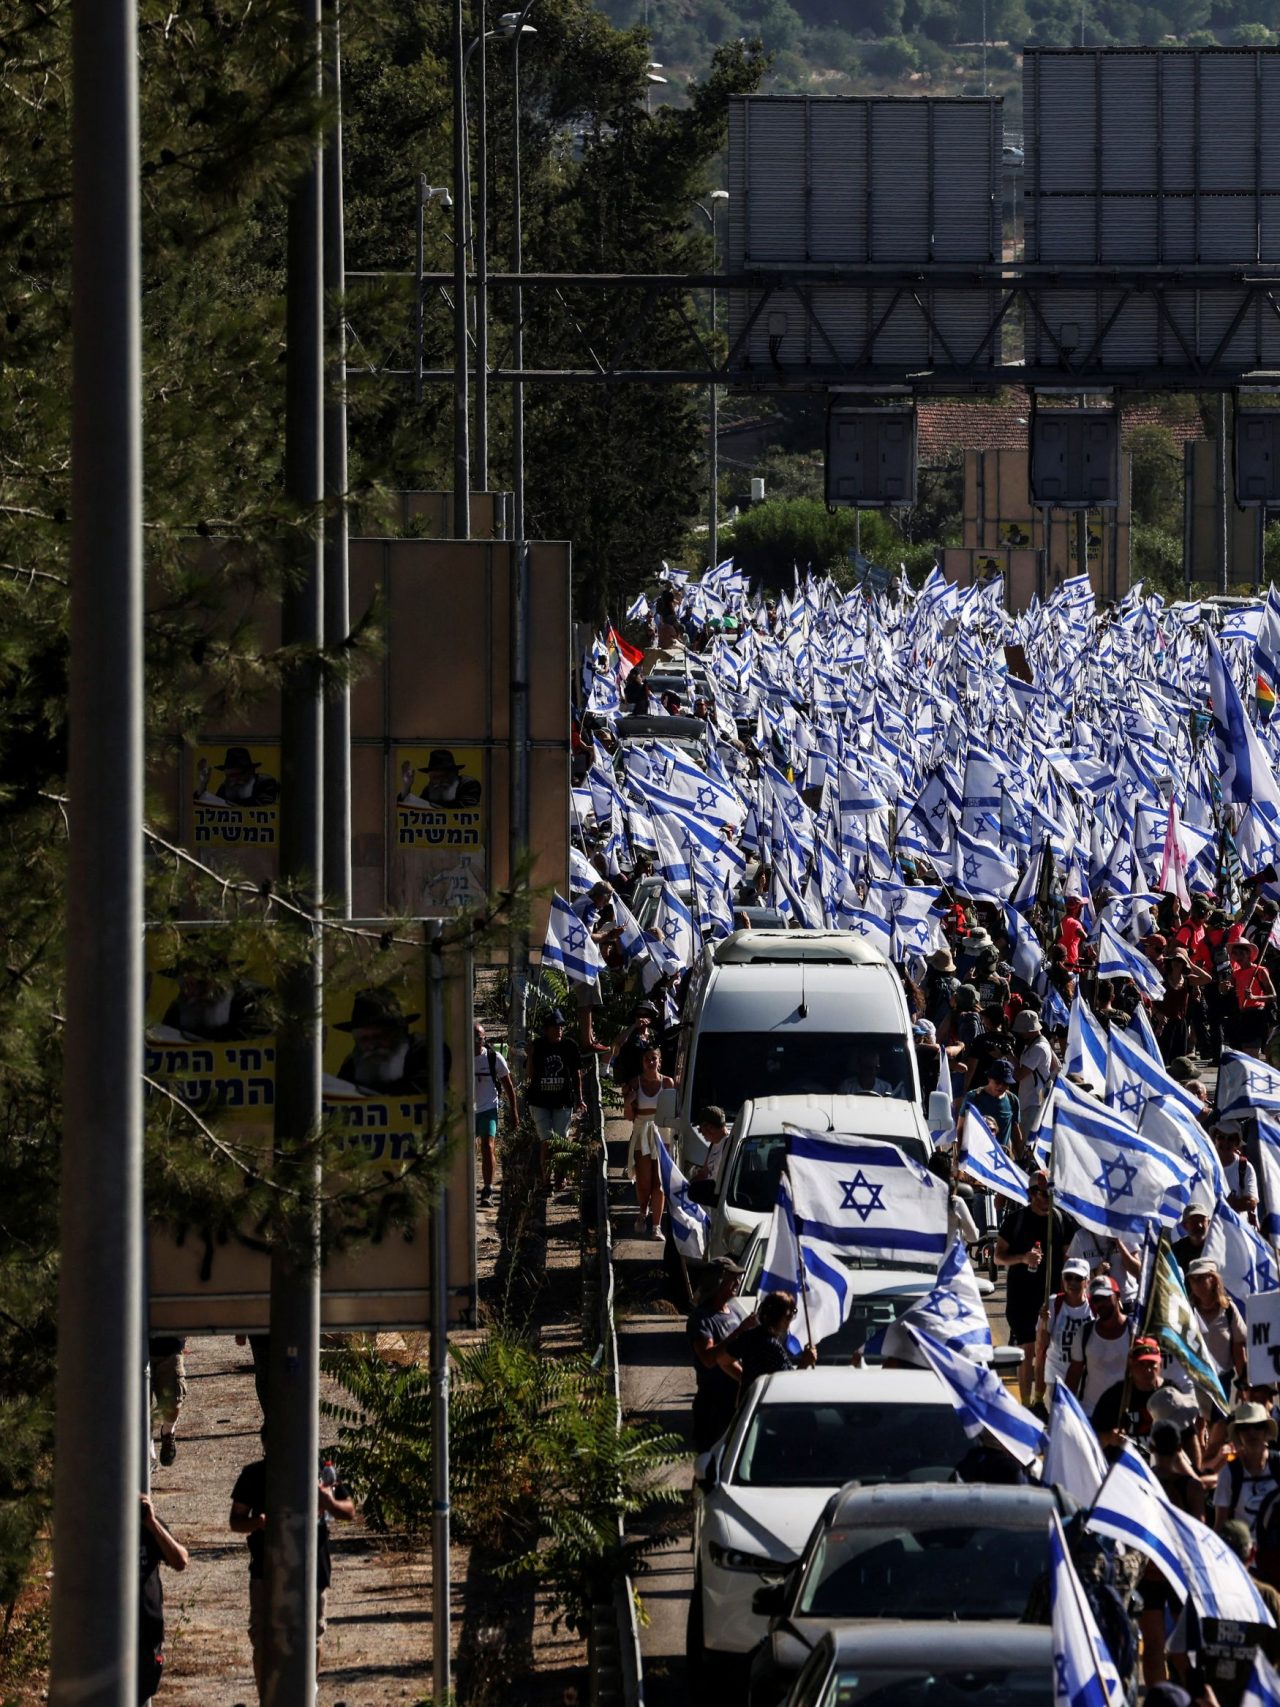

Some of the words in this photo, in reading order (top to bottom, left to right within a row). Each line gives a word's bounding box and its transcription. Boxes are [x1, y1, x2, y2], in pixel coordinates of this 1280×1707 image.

[195, 808, 243, 825] המלך
[249, 811, 276, 824] יחי
[399, 810, 447, 827] המלך
[453, 813, 479, 825] יחי
[195, 826, 274, 843] המשיח
[399, 828, 478, 844] המשיח
[144, 1049, 213, 1074] המל
[225, 1048, 275, 1071] יחי
[1252, 1322, 1270, 1346] MY
